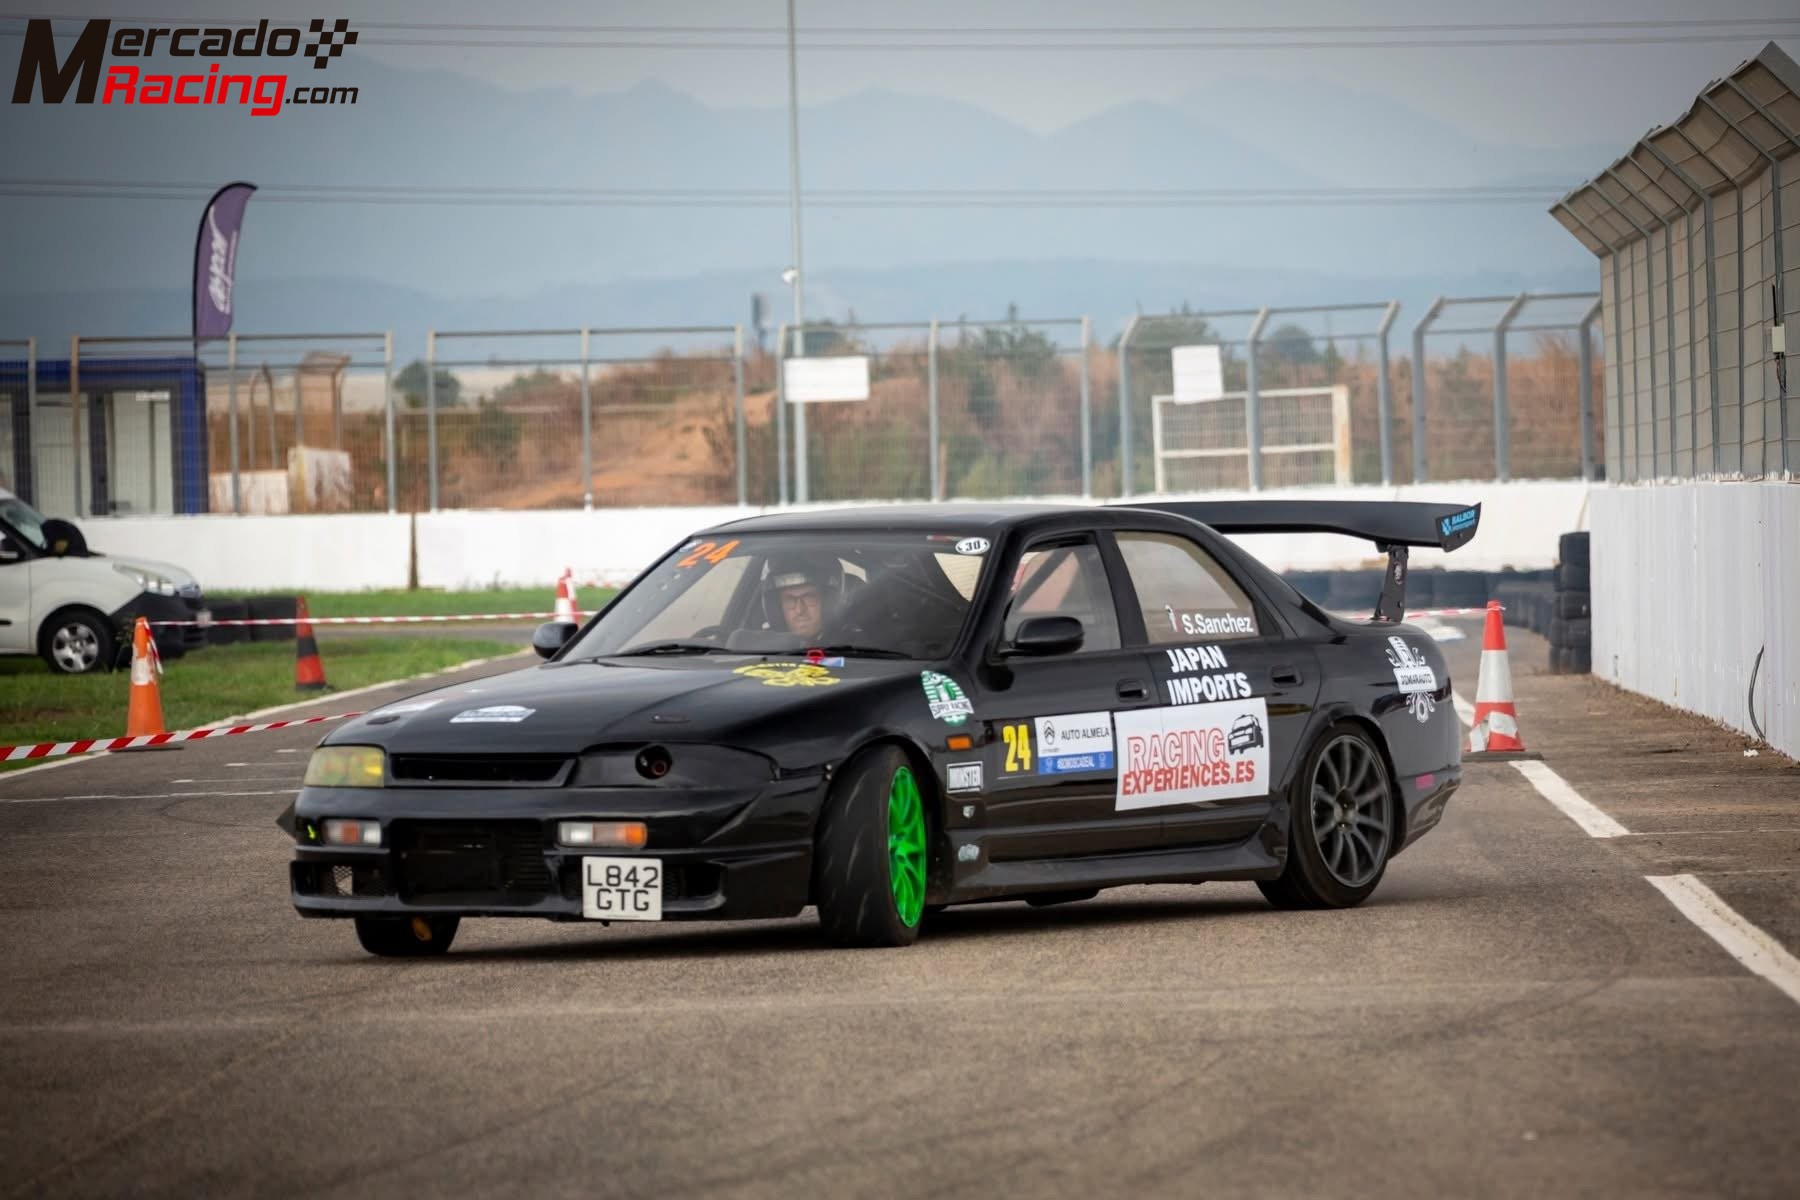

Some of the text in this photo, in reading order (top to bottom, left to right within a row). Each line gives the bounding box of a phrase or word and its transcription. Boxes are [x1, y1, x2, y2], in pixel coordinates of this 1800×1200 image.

[677, 541, 739, 567] 24
[1181, 613, 1254, 635] S.Sanchez
[1166, 645, 1228, 673] JAPAN
[1166, 672, 1252, 705] IMPORTS
[1061, 727, 1110, 740] AUTO ALMELA
[1003, 724, 1031, 772] 24
[1127, 727, 1225, 773] RACING
[1122, 760, 1255, 795] EXPERIENCES.ES
[587, 864, 658, 888] L842
[597, 888, 649, 911] GTG
